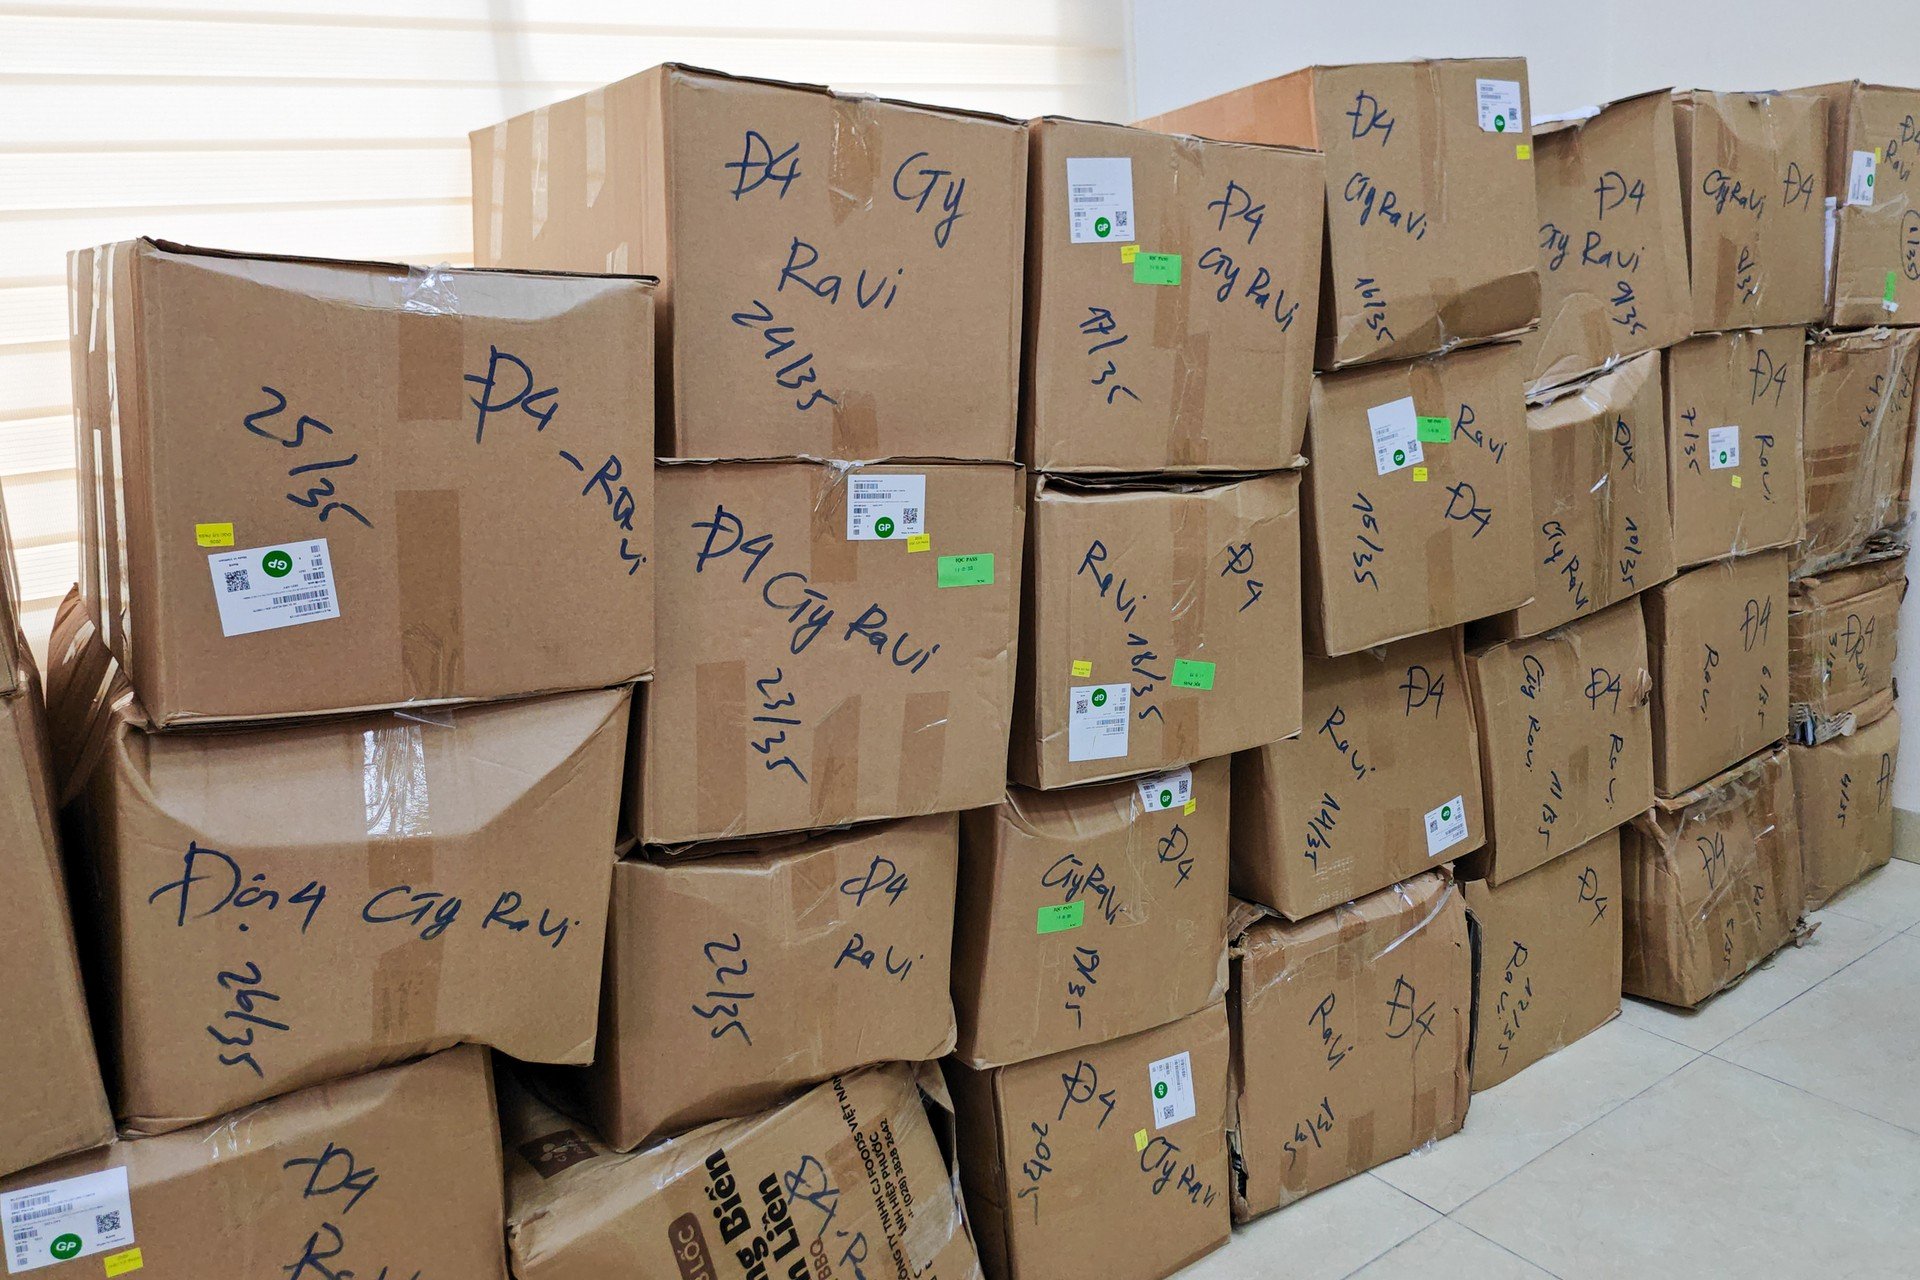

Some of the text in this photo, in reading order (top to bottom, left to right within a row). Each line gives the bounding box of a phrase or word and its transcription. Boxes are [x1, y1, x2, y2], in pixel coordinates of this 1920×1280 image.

[878, 523, 891, 532] GP
[268, 559, 288, 570] GP
[841, 1104, 858, 1133] VIỆT
[854, 1132, 876, 1178] FOODS
[890, 1147, 903, 1177] 3828
[870, 1178, 880, 1195] CJ
[885, 1181, 899, 1209] HIỆP
[898, 1176, 913, 1206] (028)
[875, 1195, 892, 1233] TNHH
[55, 1241, 77, 1252] GP
[887, 1234, 898, 1250] TY
[893, 1249, 910, 1280] ÔNG
